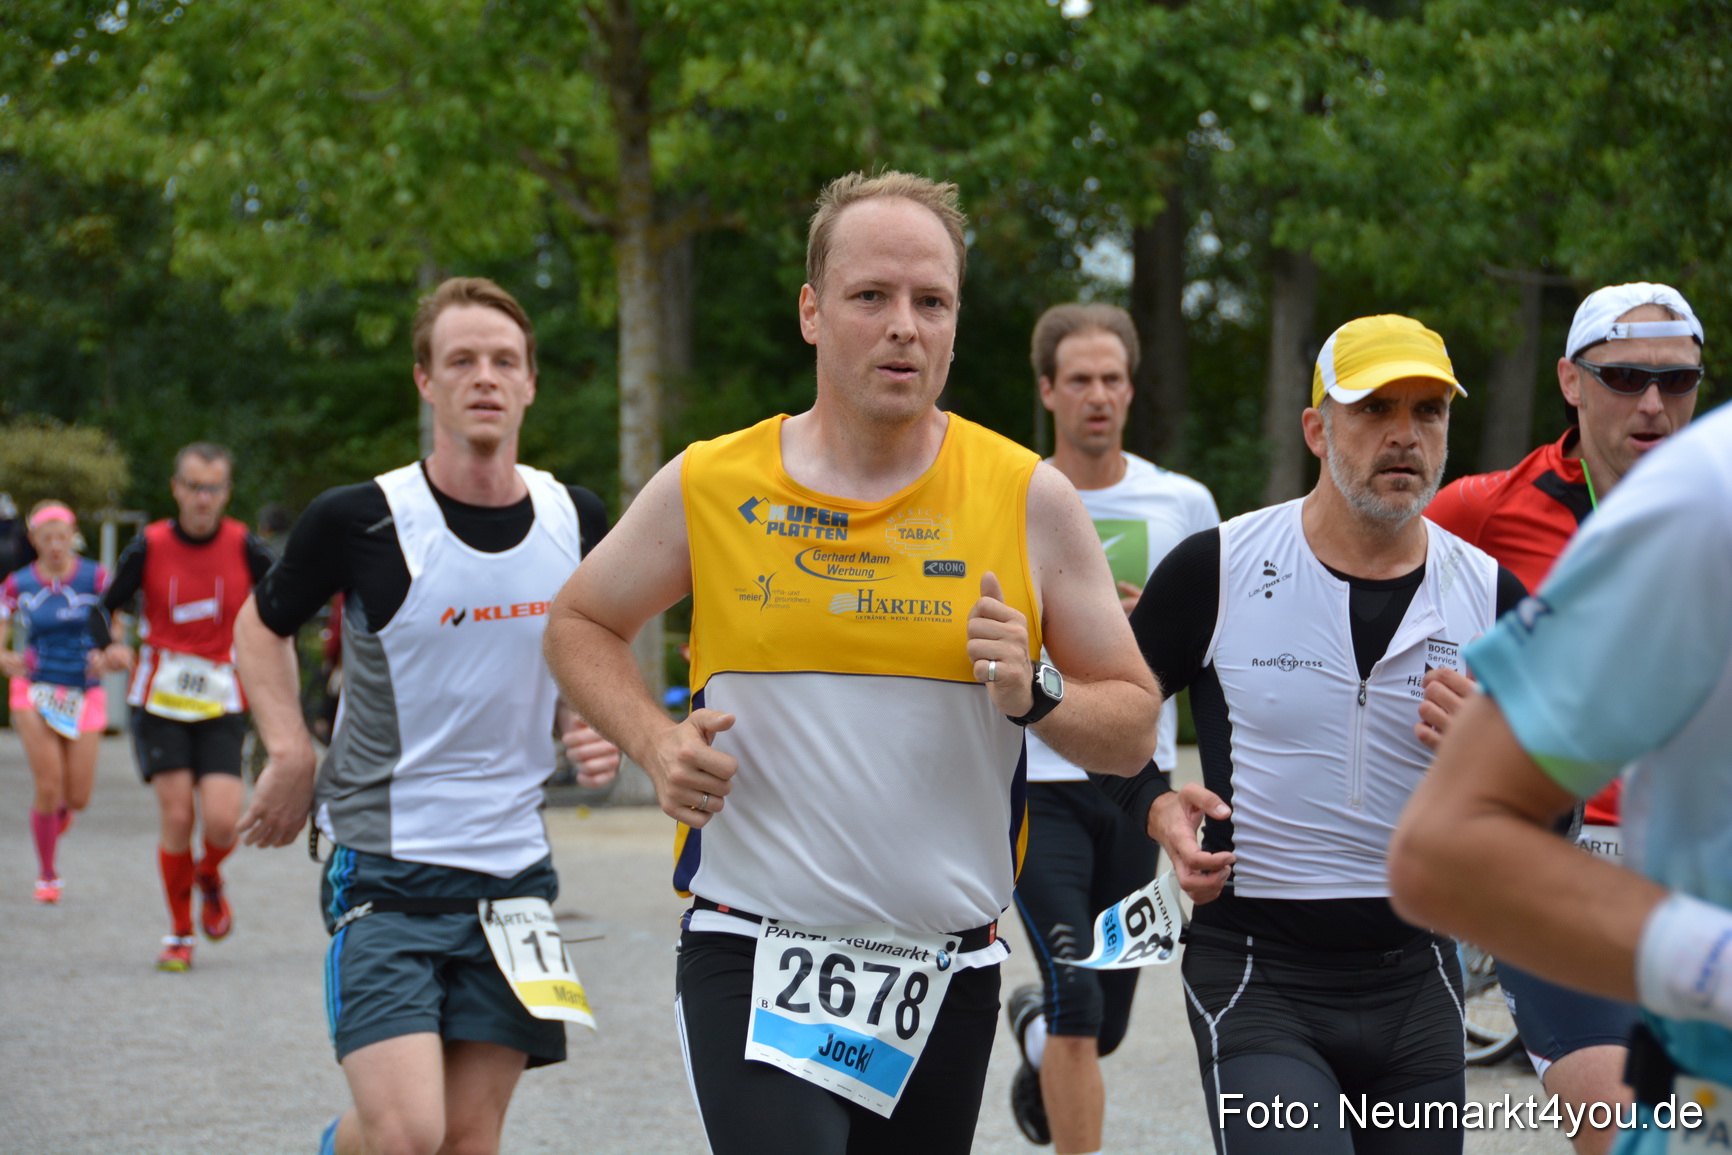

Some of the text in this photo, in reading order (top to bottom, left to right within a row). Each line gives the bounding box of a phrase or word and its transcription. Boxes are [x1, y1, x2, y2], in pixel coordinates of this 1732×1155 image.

[768, 504, 849, 527] KUFER
[766, 521, 848, 541] PLATTEN
[898, 528, 941, 540] TABAC
[812, 549, 891, 564] Gerhard Mann
[827, 564, 875, 578] Werbung
[739, 593, 763, 602] meier
[856, 588, 953, 617] HÄRTEIS
[1428, 644, 1457, 656] BOSCH
[1427, 653, 1457, 666] Service
[775, 947, 929, 1040] 2678
[760, 999, 769, 1009] B
